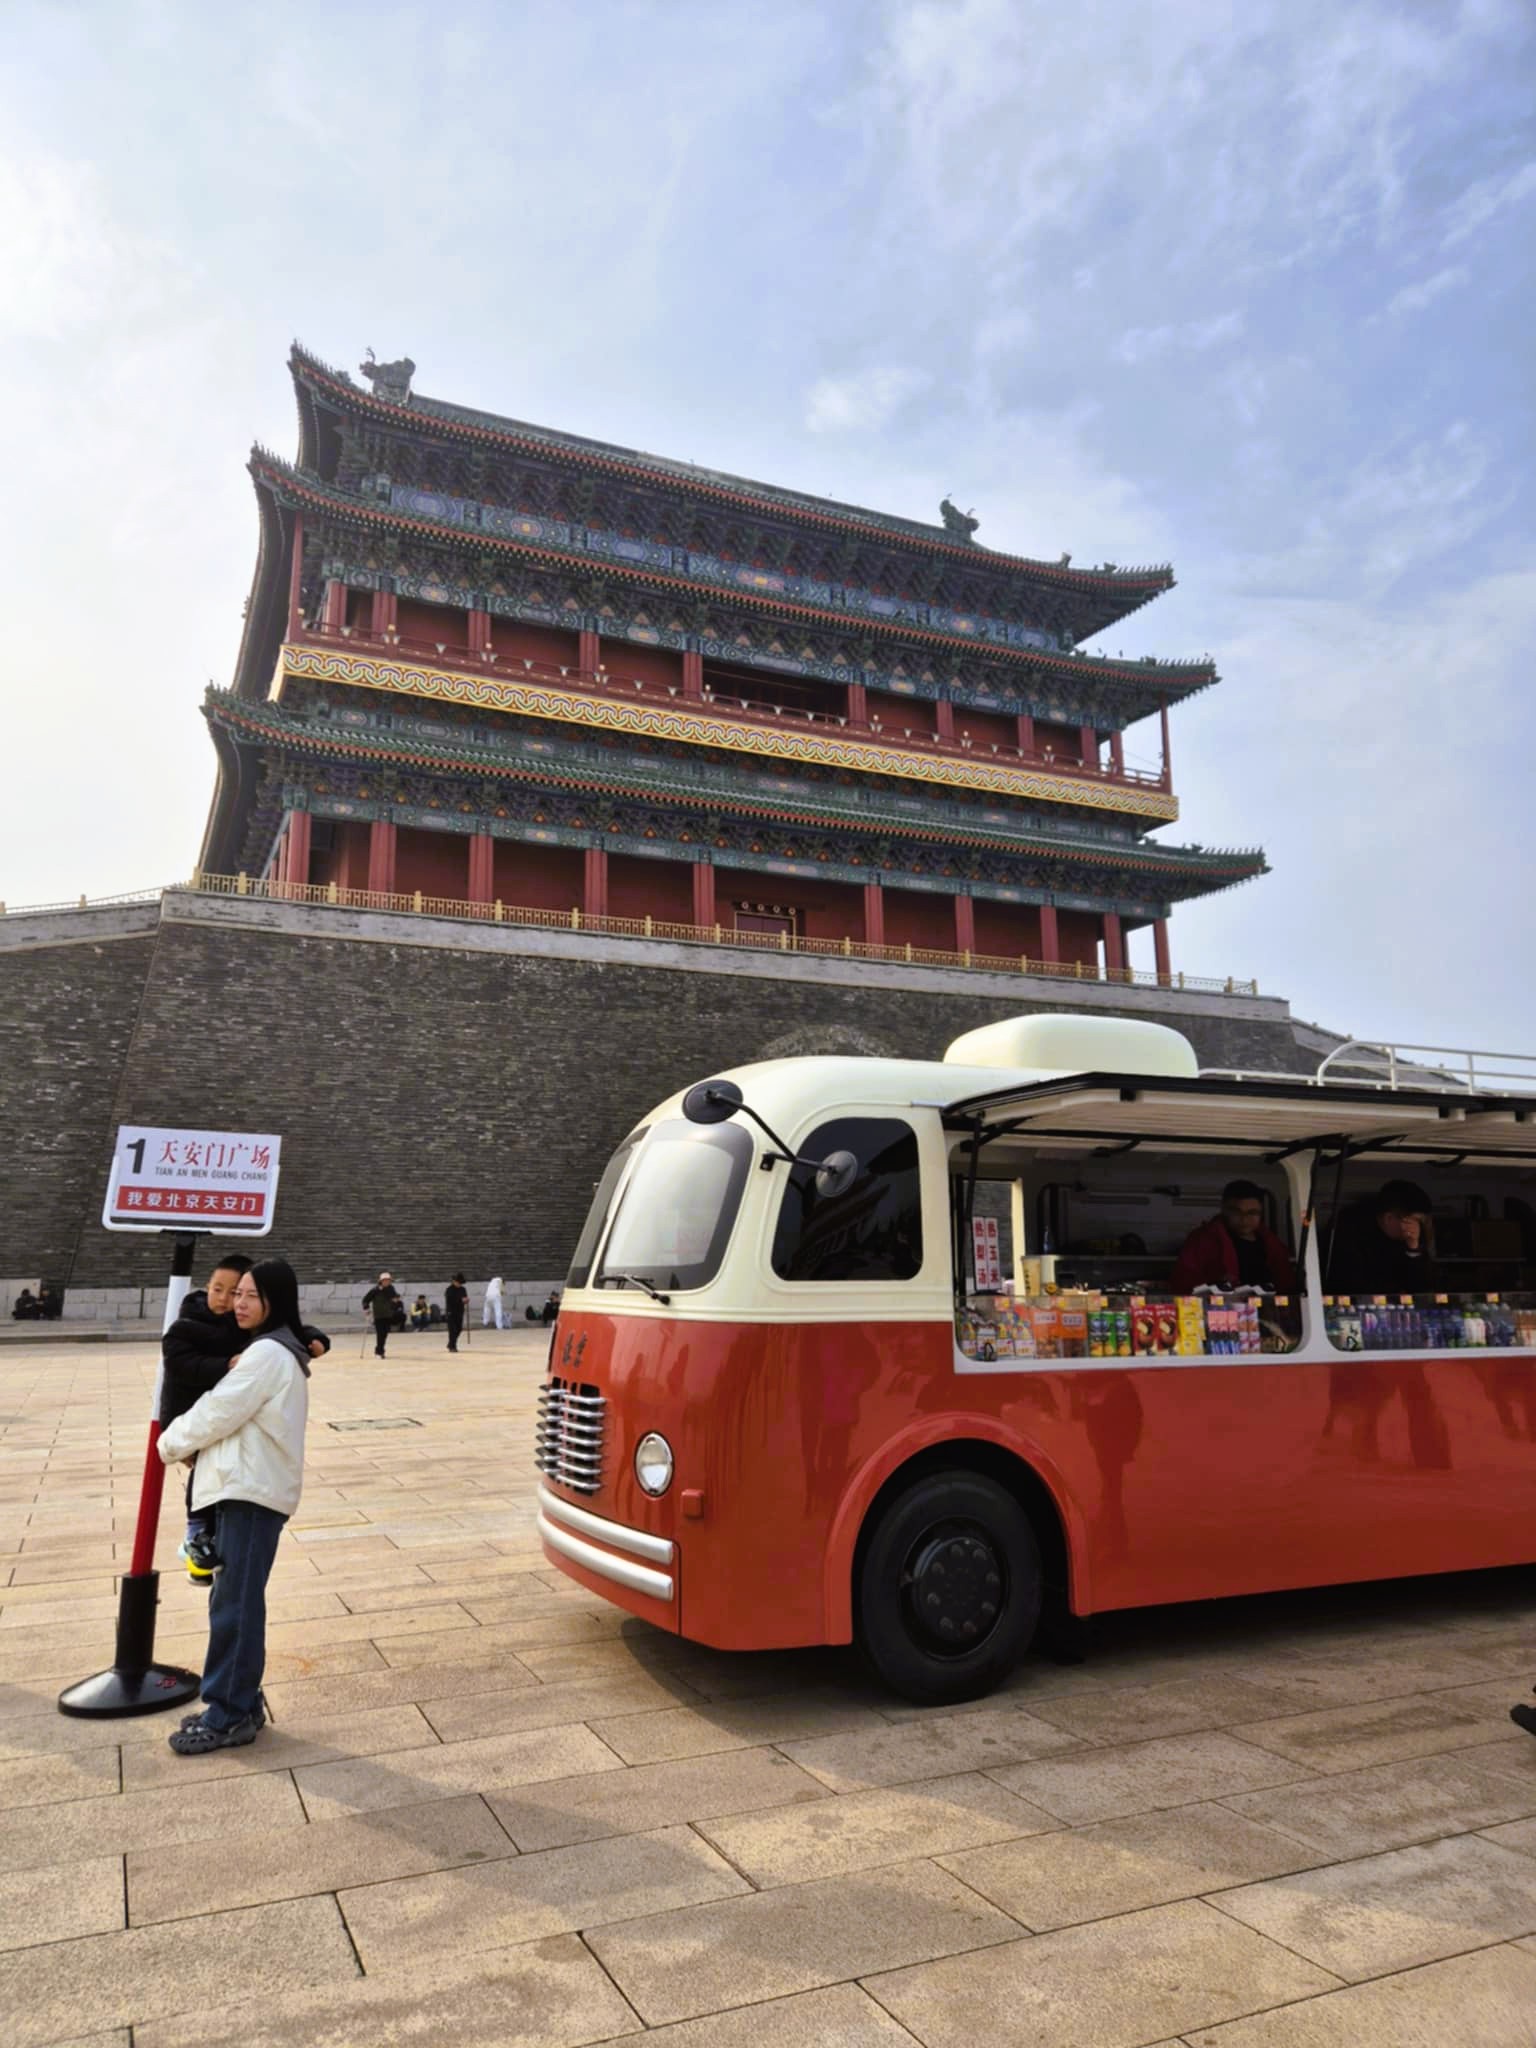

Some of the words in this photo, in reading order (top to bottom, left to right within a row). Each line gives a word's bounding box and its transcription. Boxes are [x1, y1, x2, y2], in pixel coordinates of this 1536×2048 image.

[126, 1138, 146, 1174] 1
[159, 1140, 270, 1169] 天安门广场
[155, 1166, 173, 1176] TIAN
[176, 1168, 188, 1176] AN
[211, 1169, 238, 1180] GUANG
[241, 1171, 268, 1181] CHANG
[127, 1191, 256, 1212] 我爱北京天安门
